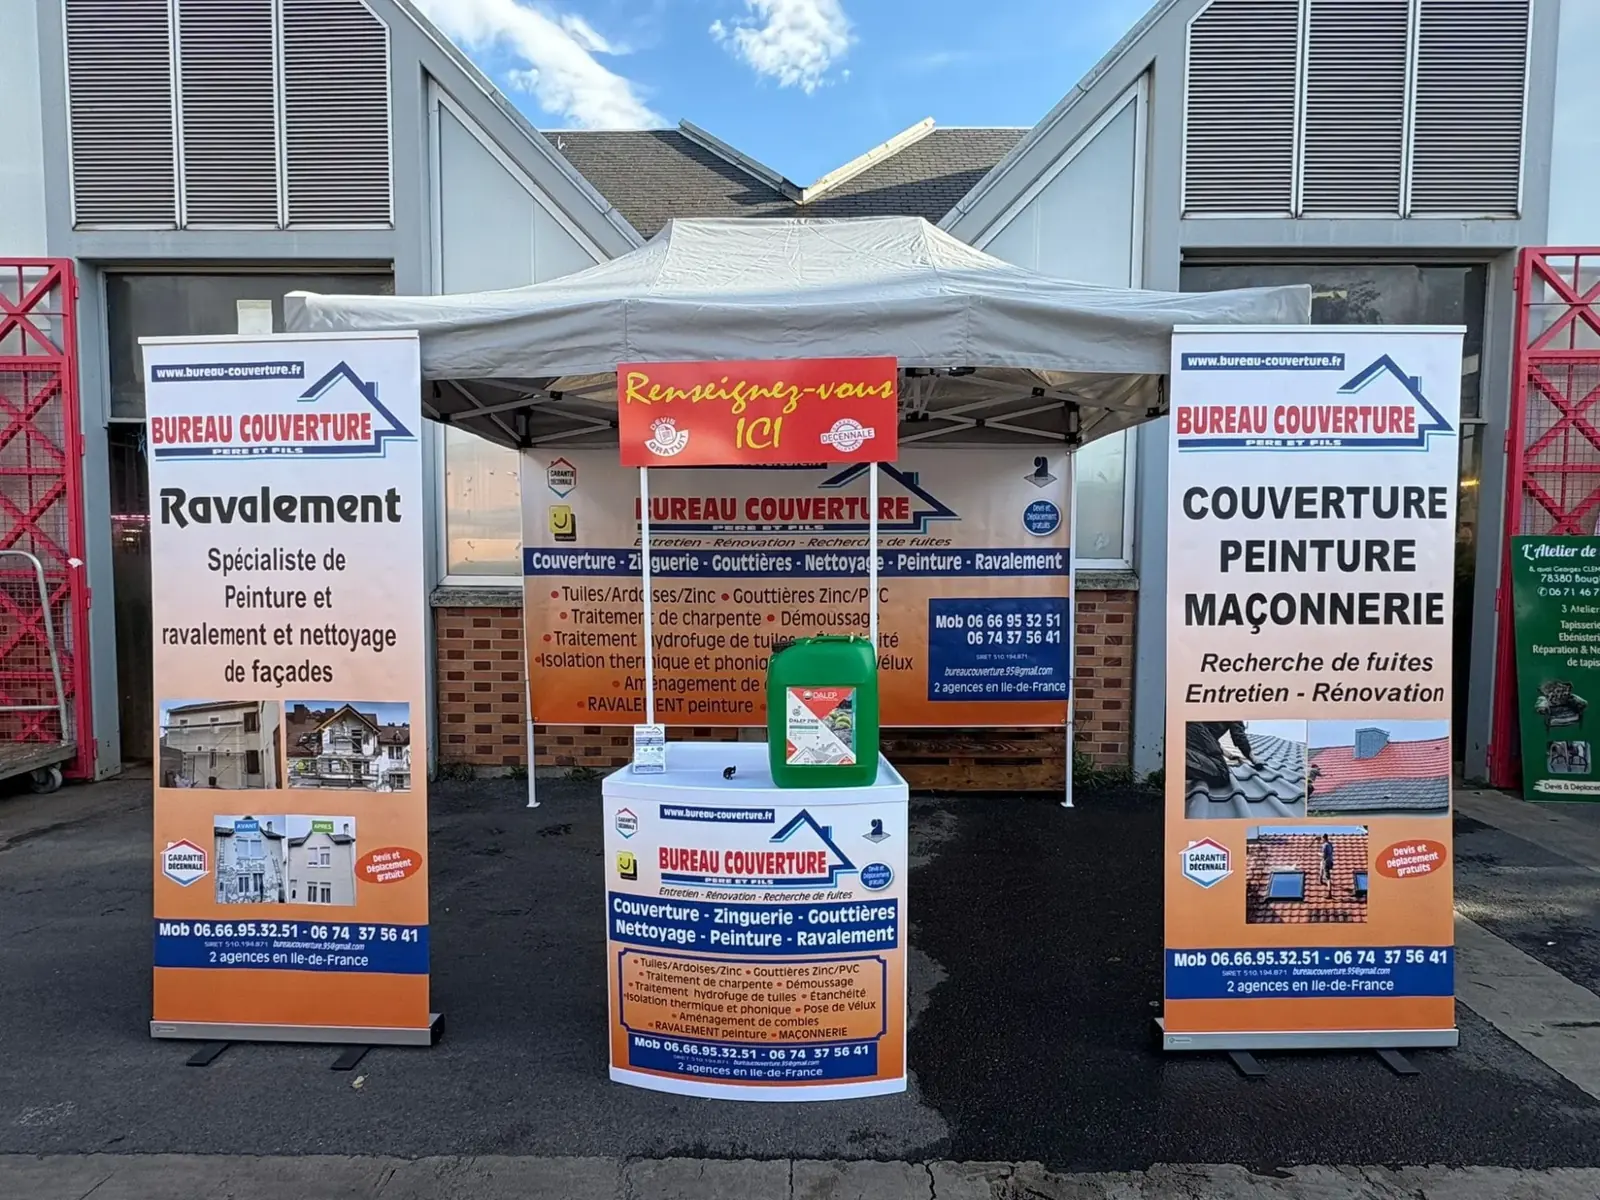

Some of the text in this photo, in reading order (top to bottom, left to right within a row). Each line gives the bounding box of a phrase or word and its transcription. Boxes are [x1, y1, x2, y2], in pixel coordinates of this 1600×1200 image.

[1187, 355, 1342, 367] www.bureau-couverture.fr
[157, 364, 301, 378] www.bureau-couverture.fr
[625, 371, 894, 414] Renseignez-vous
[649, 416, 676, 431] DEVIS
[1177, 405, 1415, 434] BUREAU COUVERTURE
[152, 413, 371, 444] BUREAU COUVERTURE
[735, 417, 783, 449] ICI
[160, 486, 402, 529] Ravalement
[1182, 486, 1447, 520] COUVERTURE
[713, 537, 905, 548] Rénovation de
[1220, 539, 1416, 573] PEINTURE
[1521, 544, 1597, 560] L'Atelier de
[208, 547, 346, 576] Spécialiste de
[532, 552, 1062, 572] Couverture Ziguerie Gouttières Peinture Ravalement
[1541, 574, 1572, 583] 78380
[225, 585, 332, 608] Peinture et
[733, 587, 815, 604] Gouttières
[1549, 588, 1591, 596] 06 46
[659, 609, 762, 628] de charpente
[936, 613, 1060, 629] Mob 06 66 95 32 51
[1185, 592, 1444, 634] MAÇONNERIE
[163, 622, 397, 652] ravalement et nettoyage
[553, 630, 749, 648] Traitement de
[967, 630, 1060, 645] 06 74 37 56 41
[1532, 645, 1588, 656] Réparation &
[541, 653, 710, 670] Isolation et
[1201, 652, 1434, 673] Recherche de fuites
[1567, 657, 1578, 666] de
[225, 659, 333, 688] de façades
[944, 666, 1053, 677] bureaucouverture.95@gmail.com
[741, 677, 759, 691] de
[942, 681, 1066, 694] agences en Ile-de-France
[1185, 682, 1444, 703] Entretien Rénovation
[688, 698, 753, 714] peinture
[664, 808, 773, 820] www.bureau-couverture.fr
[168, 854, 204, 862] GARANTIE
[366, 858, 412, 874] Déplacement
[659, 847, 826, 875] BUREAU COUVERTURE
[1189, 853, 1227, 862] GARANTIE
[1386, 853, 1439, 868] Déplacement
[377, 869, 405, 882] gratuits
[1397, 863, 1431, 877] gratuits
[659, 887, 825, 901] Entretien Rénovation Recherche de
[613, 898, 896, 927] Couverture Zinguerie Gouttières
[160, 922, 418, 942] Mob 06.66.95.32.51 06 74 37 56 41
[616, 919, 895, 946] Nettoyage Peinture Ravalement
[209, 951, 369, 966] 2 agences en Ile-de-France
[1174, 949, 1447, 967] Mob 06.66.95.32.51 06 74 37 56 41
[640, 958, 860, 977] Tuiles/Ardoises/Zinc Gouttières Zinc/PVC
[646, 970, 854, 990] Traitement de charpente Démoussage
[1227, 979, 1394, 994] 2 agences en Ile-de-France
[635, 981, 866, 1002] Traitement hydrofuge de Étanchéité
[626, 992, 876, 1016] Isolation thermique et phonique Pose de Vélux
[679, 1012, 819, 1027] Aménagement de combles
[655, 1021, 848, 1040] RAVALEMENT peinture MAÇONNERIE
[634, 1037, 660, 1049] Mob
[664, 1042, 756, 1059] 06.66.95.32.51
[769, 1049, 785, 1060] 06
[790, 1049, 806, 1060] 74
[814, 1048, 830, 1058] 37
[834, 1046, 850, 1057] 56
[853, 1045, 869, 1055] 41
[686, 1064, 823, 1077] agences en Ile-de-France
